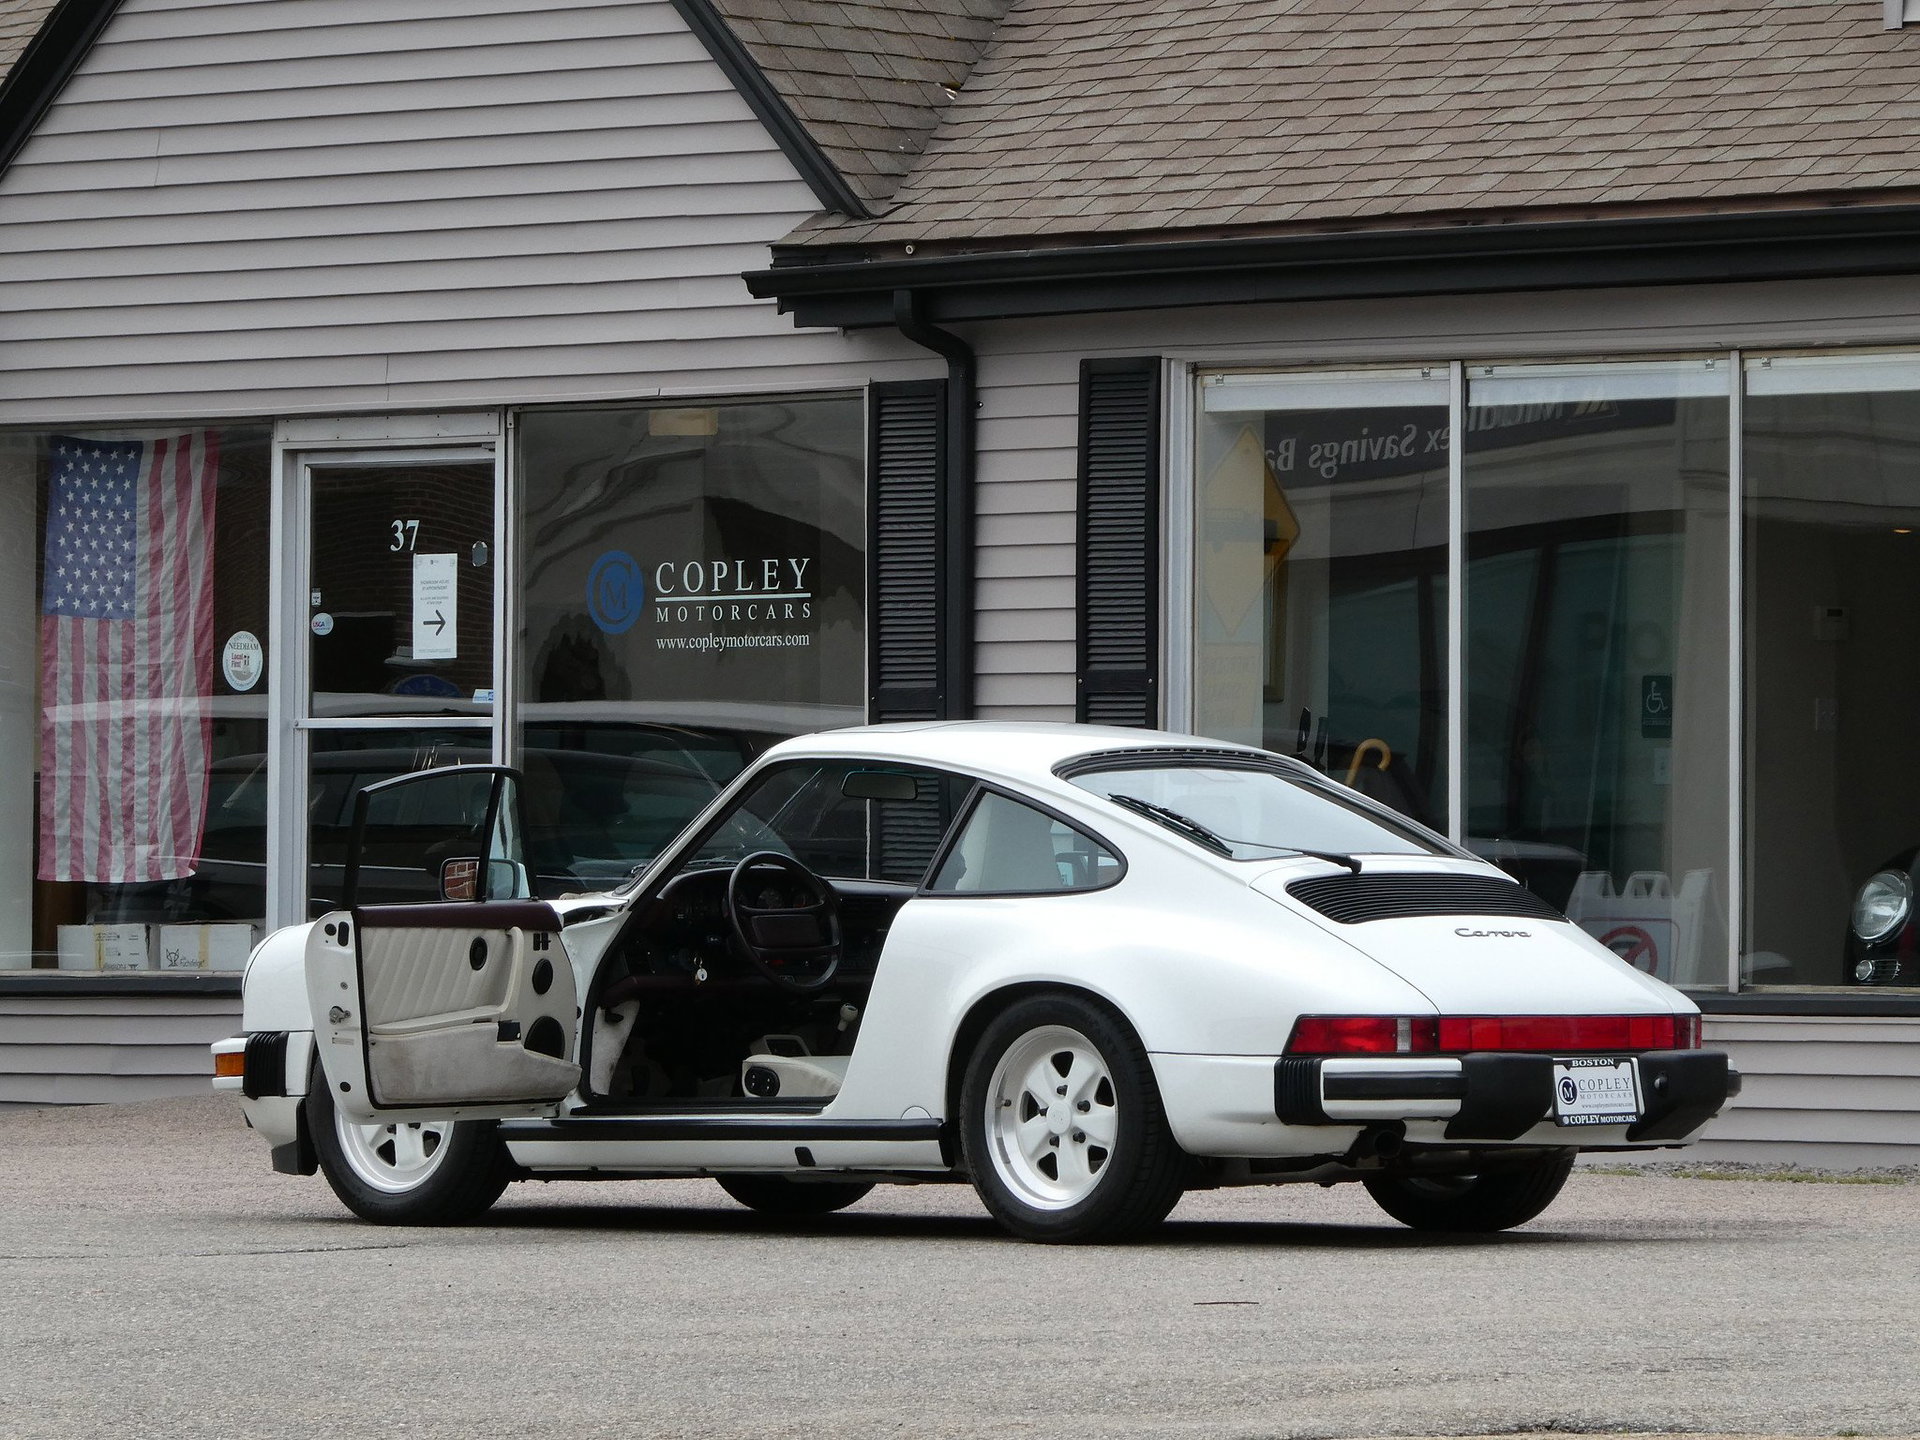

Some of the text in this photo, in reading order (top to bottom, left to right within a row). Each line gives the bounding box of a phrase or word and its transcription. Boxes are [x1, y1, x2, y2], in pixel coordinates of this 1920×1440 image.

[390, 519, 420, 551] 37
[655, 558, 811, 594] COPLEY
[656, 602, 811, 623] MOTORCARS
[228, 642, 259, 651] NEEDHAM
[656, 632, 810, 653] www.copleymotorcars.com
[1454, 928, 1532, 938] Carrera
[1572, 1058, 1614, 1067] BOSTON
[1578, 1078, 1631, 1090] COPLEY
[1570, 1115, 1636, 1125] COPLEY MOTORCARS
